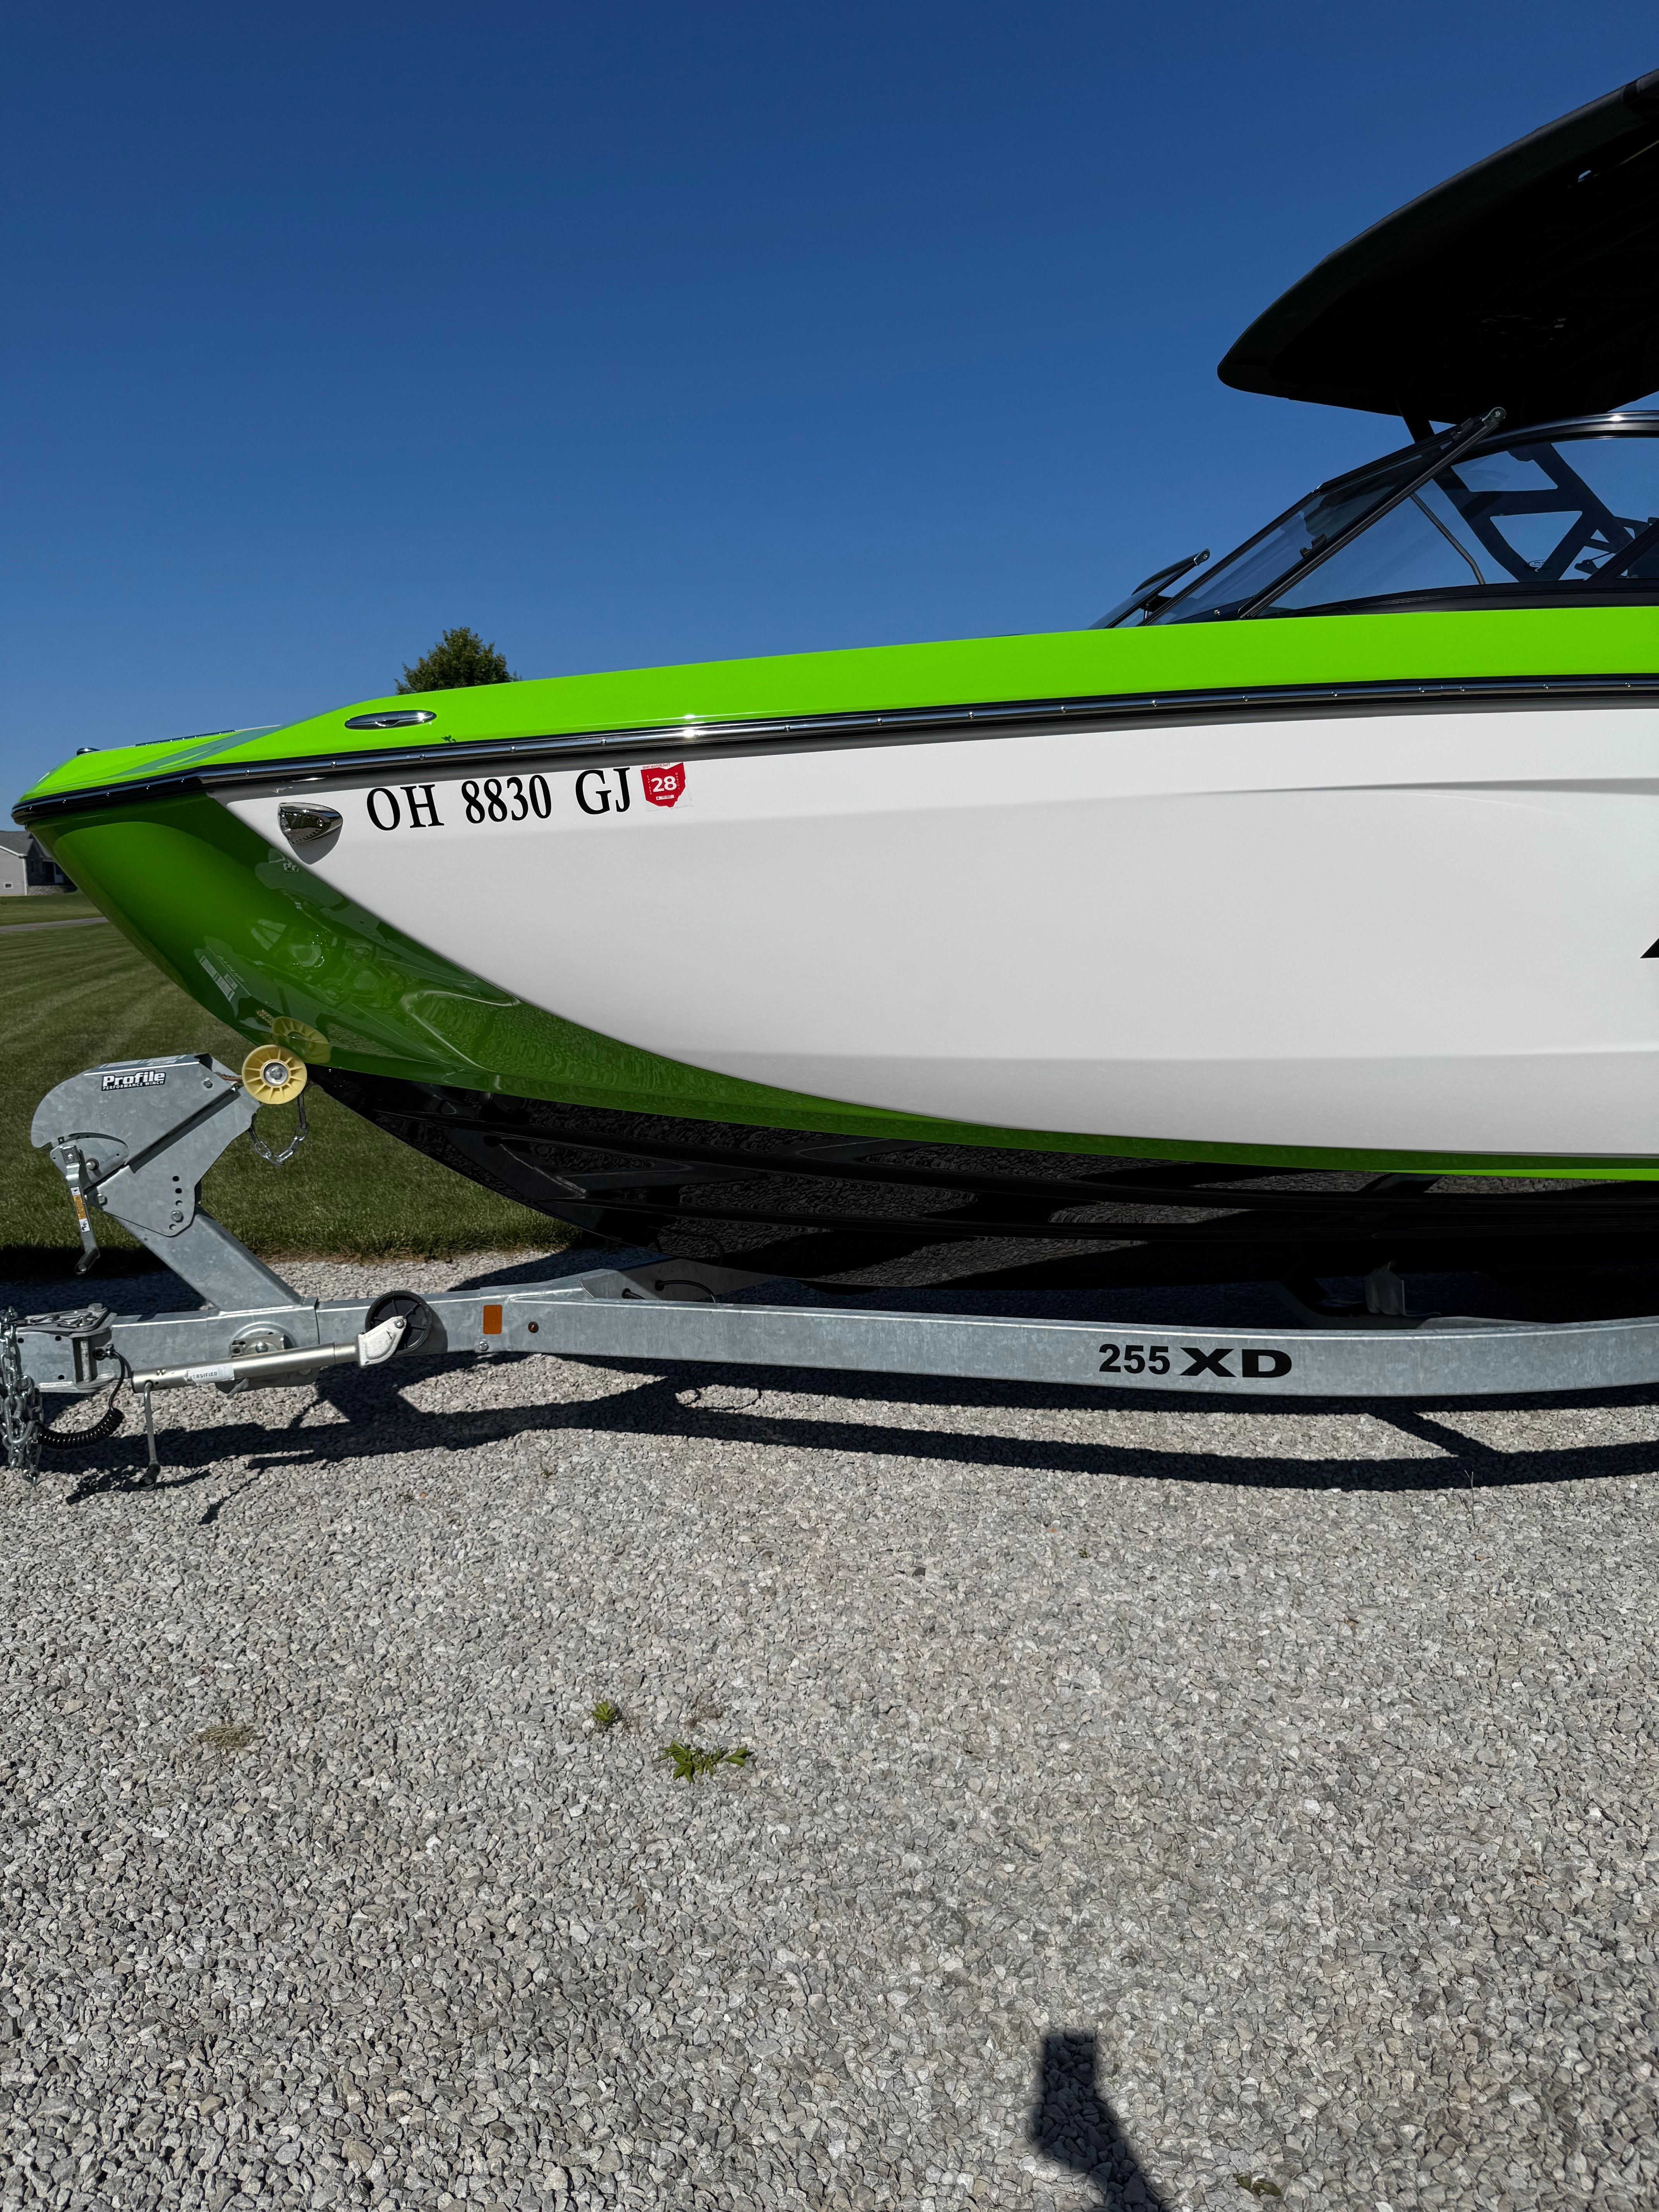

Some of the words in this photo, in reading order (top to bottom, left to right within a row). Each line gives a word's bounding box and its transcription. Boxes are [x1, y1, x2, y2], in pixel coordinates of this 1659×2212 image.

[651, 776, 677, 792] 28
[367, 784, 445, 831] OH
[461, 775, 551, 824] 8830
[575, 767, 630, 815] GJ
[103, 1071, 165, 1087] Profile
[1098, 1343, 1170, 1375] 255
[1179, 1347, 1292, 1378] XD
